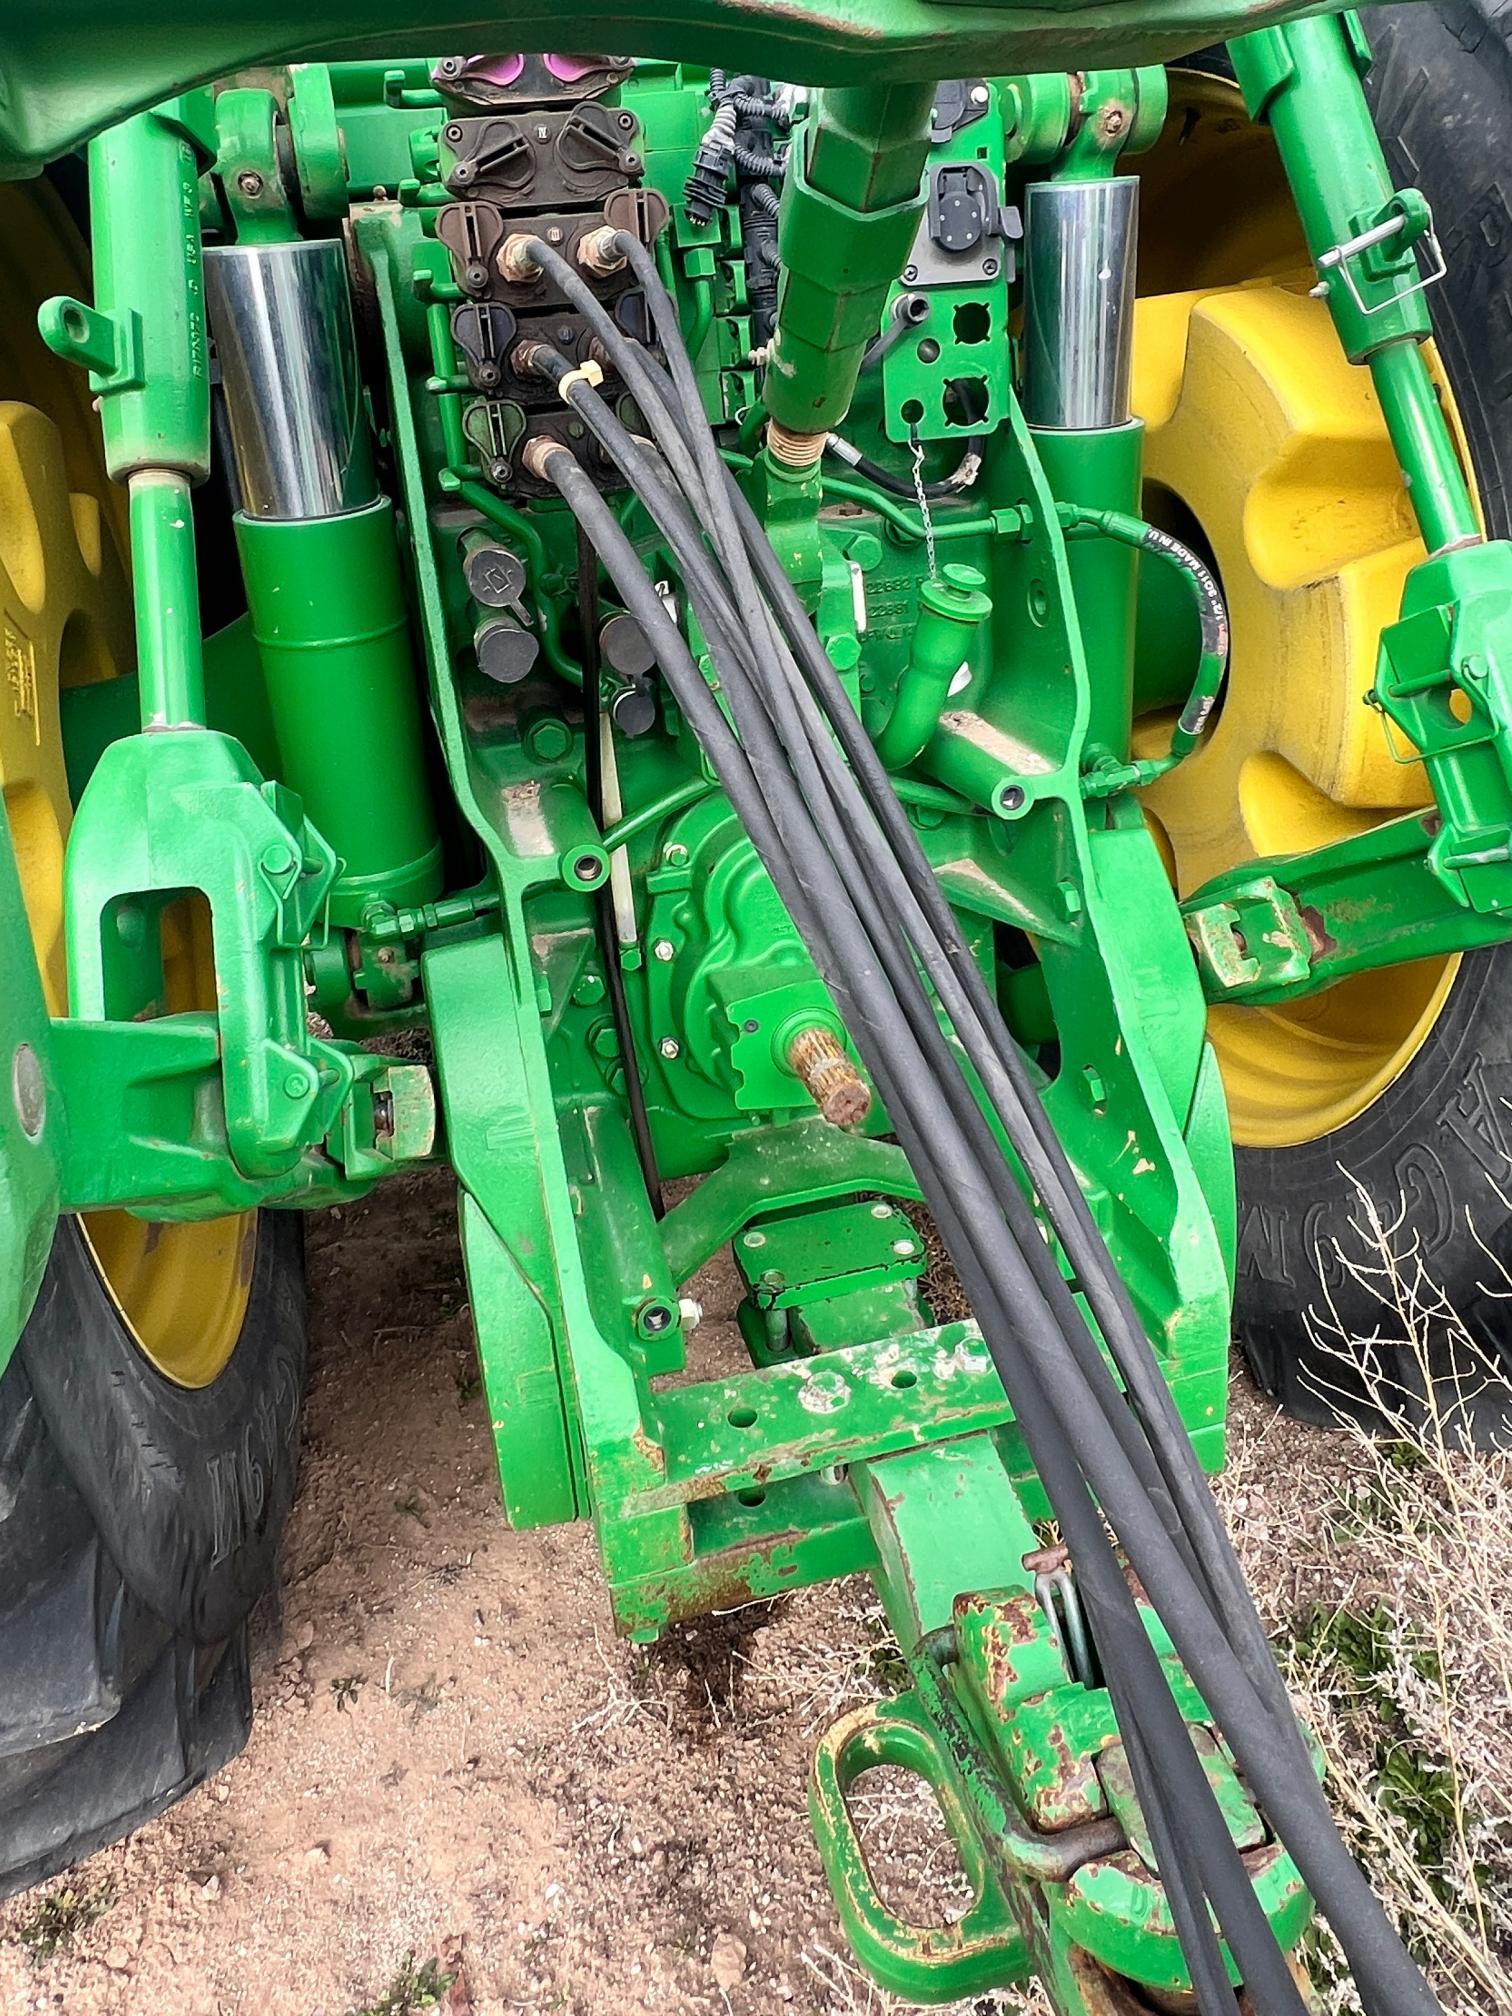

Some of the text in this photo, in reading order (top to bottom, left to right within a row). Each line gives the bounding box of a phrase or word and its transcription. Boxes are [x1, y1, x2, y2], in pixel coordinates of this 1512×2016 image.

[1158, 535, 1171, 547] IN
[1170, 542, 1201, 571] MADE
[1210, 599, 1225, 620] 1/2"
